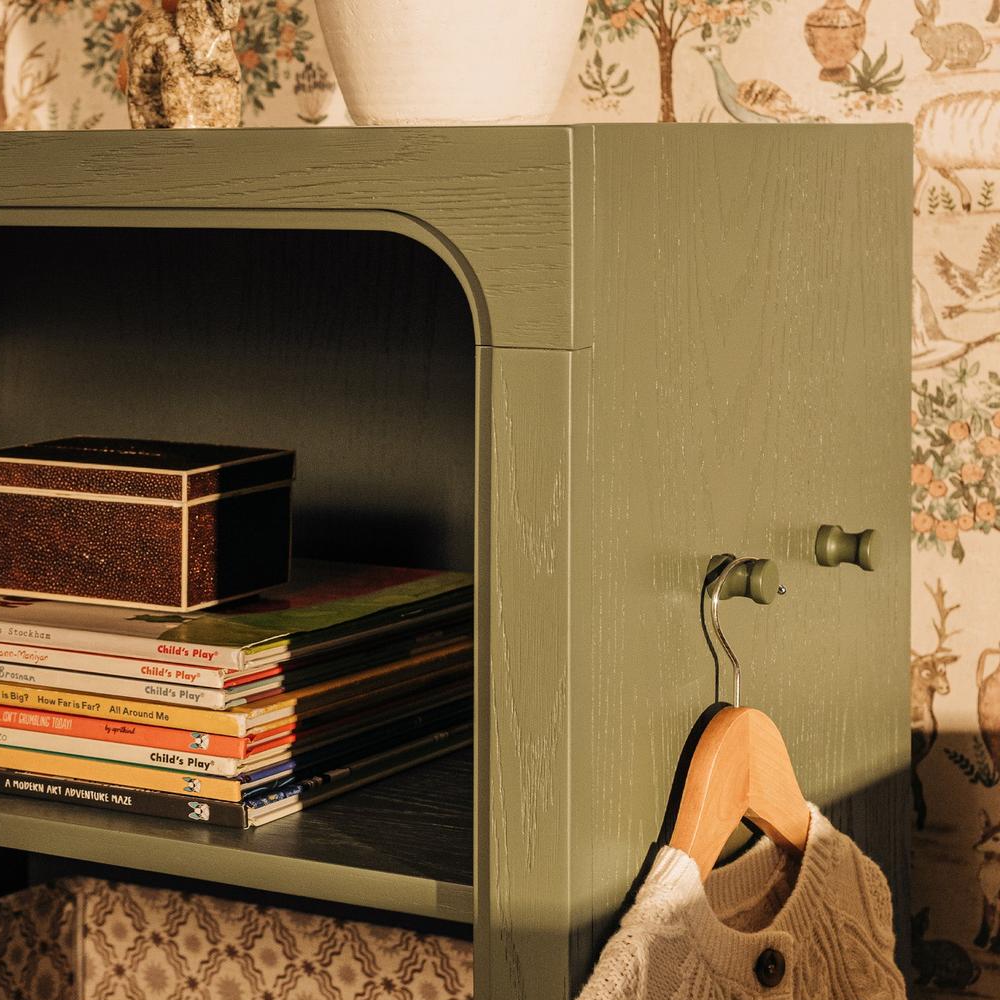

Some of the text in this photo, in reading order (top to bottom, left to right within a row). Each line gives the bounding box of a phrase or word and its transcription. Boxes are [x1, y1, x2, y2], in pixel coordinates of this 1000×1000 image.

[8, 627, 51, 640] Stockham
[157, 645, 189, 657] Child's
[0, 665, 36, 682] Brosnan
[140, 666, 172, 678] Child's
[144, 686, 176, 697] Child's
[2, 690, 9, 698] is
[10, 692, 29, 703] Big?
[37, 695, 56, 705] How
[57, 698, 71, 707] Far
[72, 700, 80, 708] is
[82, 701, 101, 712] Far?
[109, 705, 121, 714] All
[122, 707, 154, 719] Around
[156, 711, 170, 721] Me
[104, 724, 111, 734] by
[150, 752, 184, 766] Child's
[4, 779, 133, 806] A MODERN ART ADVENTURE MAZE
